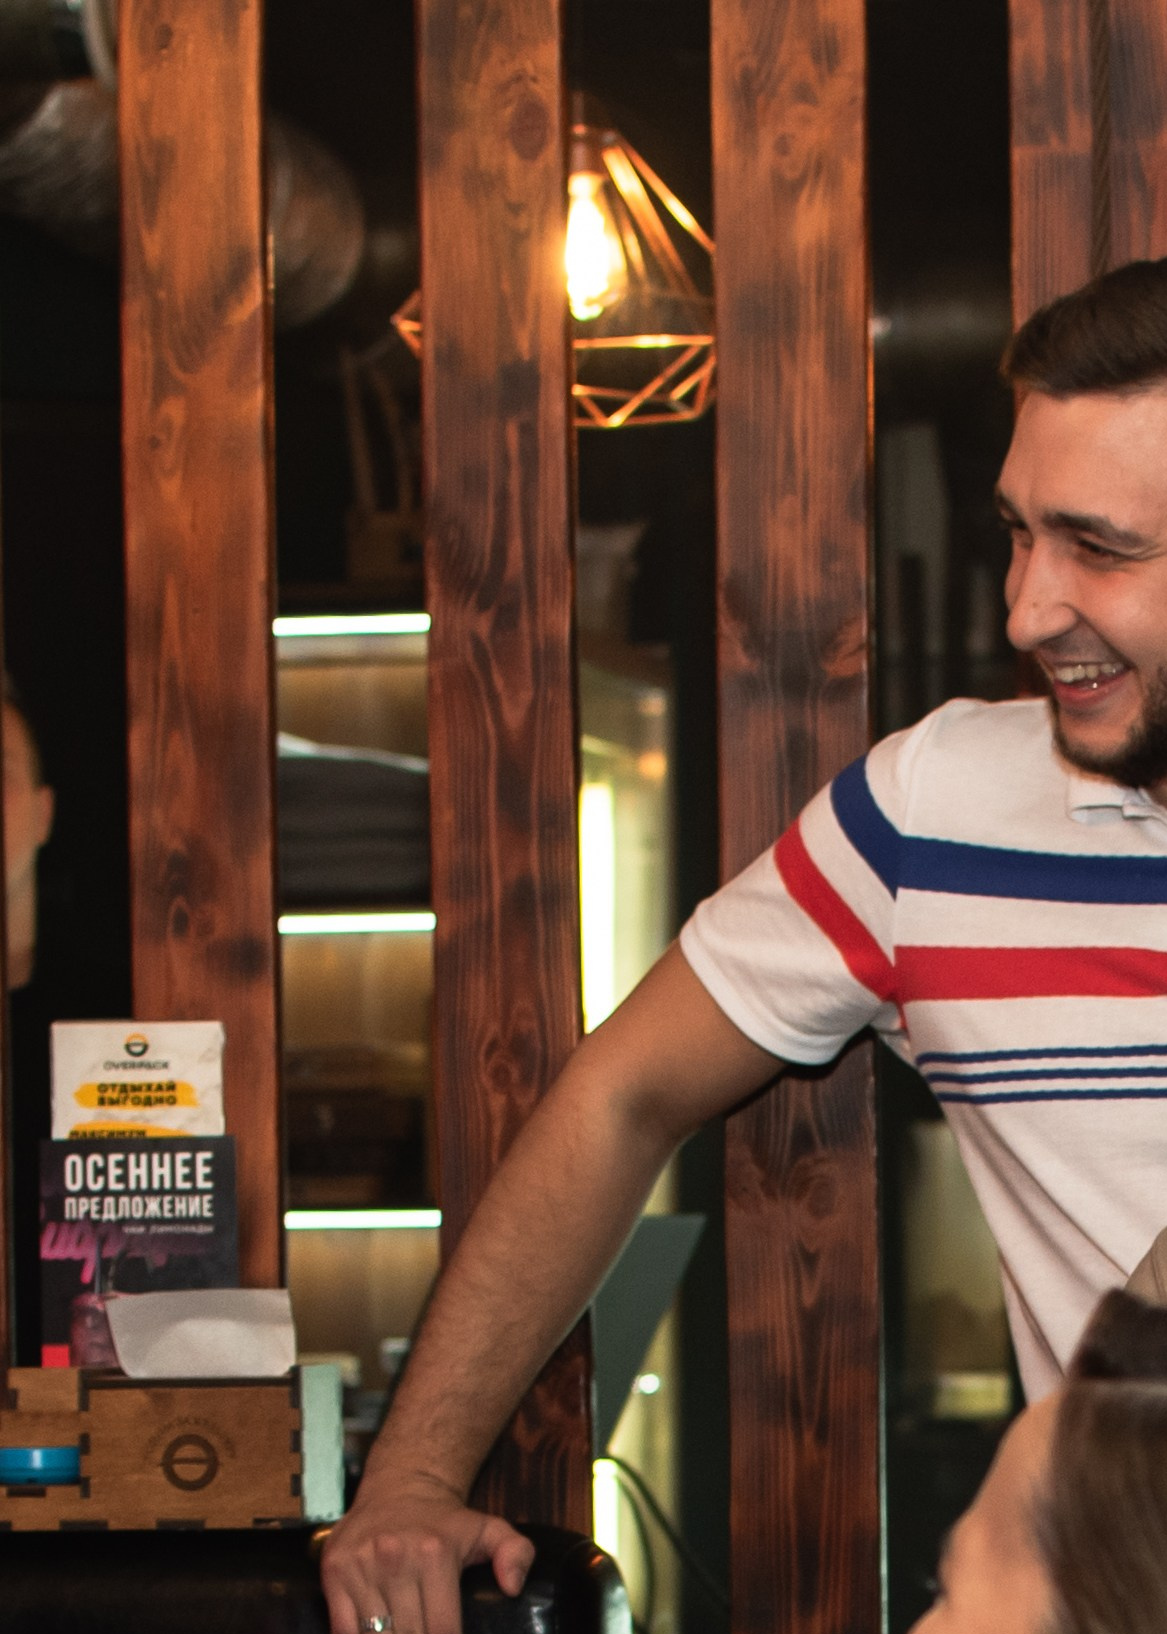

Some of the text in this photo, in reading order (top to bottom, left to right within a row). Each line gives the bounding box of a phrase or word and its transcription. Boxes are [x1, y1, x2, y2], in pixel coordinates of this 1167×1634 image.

[97, 1081, 176, 1093] ОТДЫХАЙ
[97, 1095, 177, 1106] ВЫГОДНО
[64, 1151, 214, 1191] ОСЕННЕЕ
[64, 1195, 214, 1222] ПРЕДЛОЖЕНИЕ
